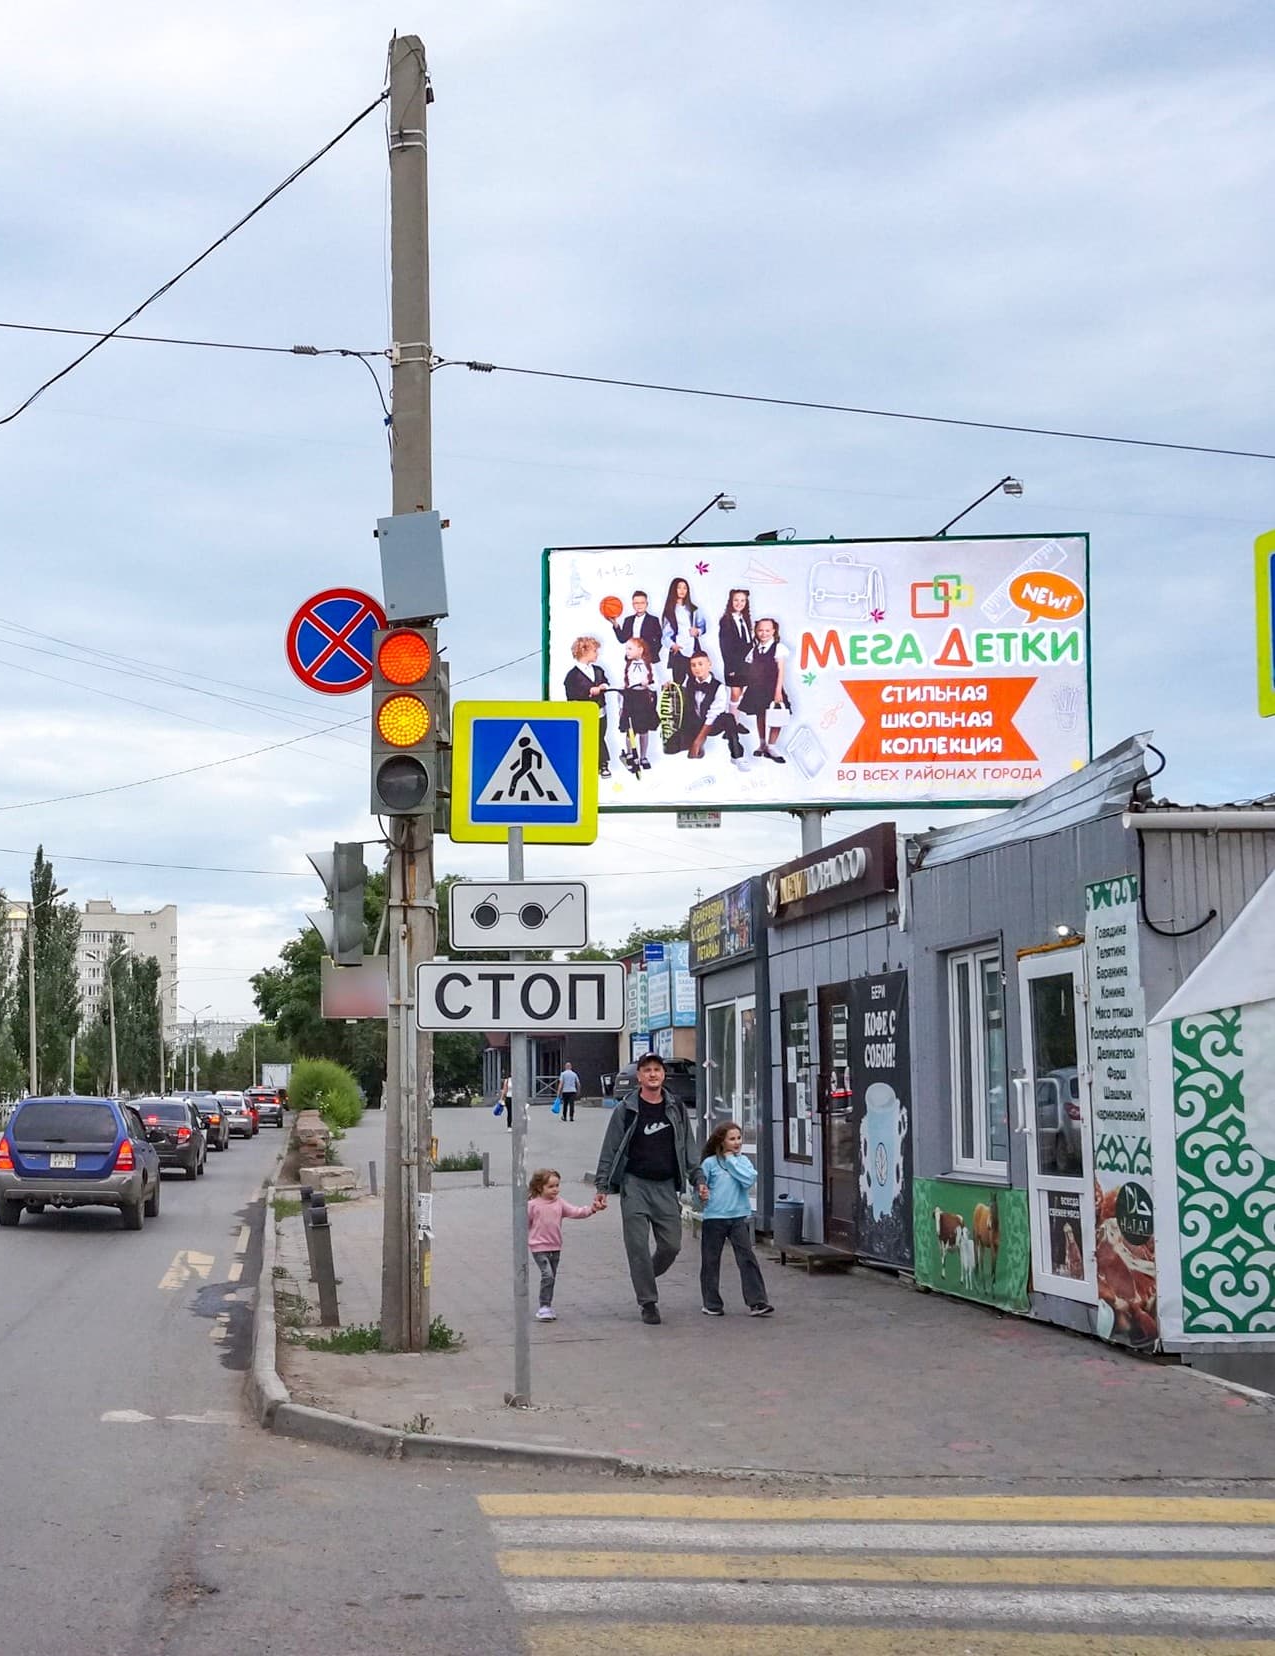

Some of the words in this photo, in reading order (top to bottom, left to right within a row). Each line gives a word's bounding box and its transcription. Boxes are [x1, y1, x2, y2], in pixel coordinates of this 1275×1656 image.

[1021, 583, 1072, 612] NEW!
[881, 685, 988, 703] СТИЛЬНАЯ
[881, 711, 993, 729] ШКОЛЬНАЯ
[881, 737, 1003, 755] КОЛЛЕКЦИЯ
[837, 770, 857, 781] ВО
[863, 769, 899, 780] ВСЕХ
[905, 766, 976, 780] РАЙОНАХ
[983, 767, 1042, 780] ГОРОДА
[780, 869, 808, 904] NEW
[804, 847, 866, 895] TOBACCO
[1095, 924, 1127, 939] Говядина
[1096, 945, 1126, 960] Телятина
[1096, 965, 1128, 980] Баранина
[435, 972, 606, 1021] СТОП
[871, 984, 885, 999] БЕРИ
[1101, 985, 1125, 999] Конина
[864, 1010, 888, 1036] КОФЕ
[889, 1009, 896, 1035] С
[864, 1036, 896, 1068] СОБОЙ!
[1097, 1046, 1135, 1060] Деликатесы
[1107, 1066, 1126, 1080] Фарш
[1103, 1086, 1133, 1100] Шашлык
